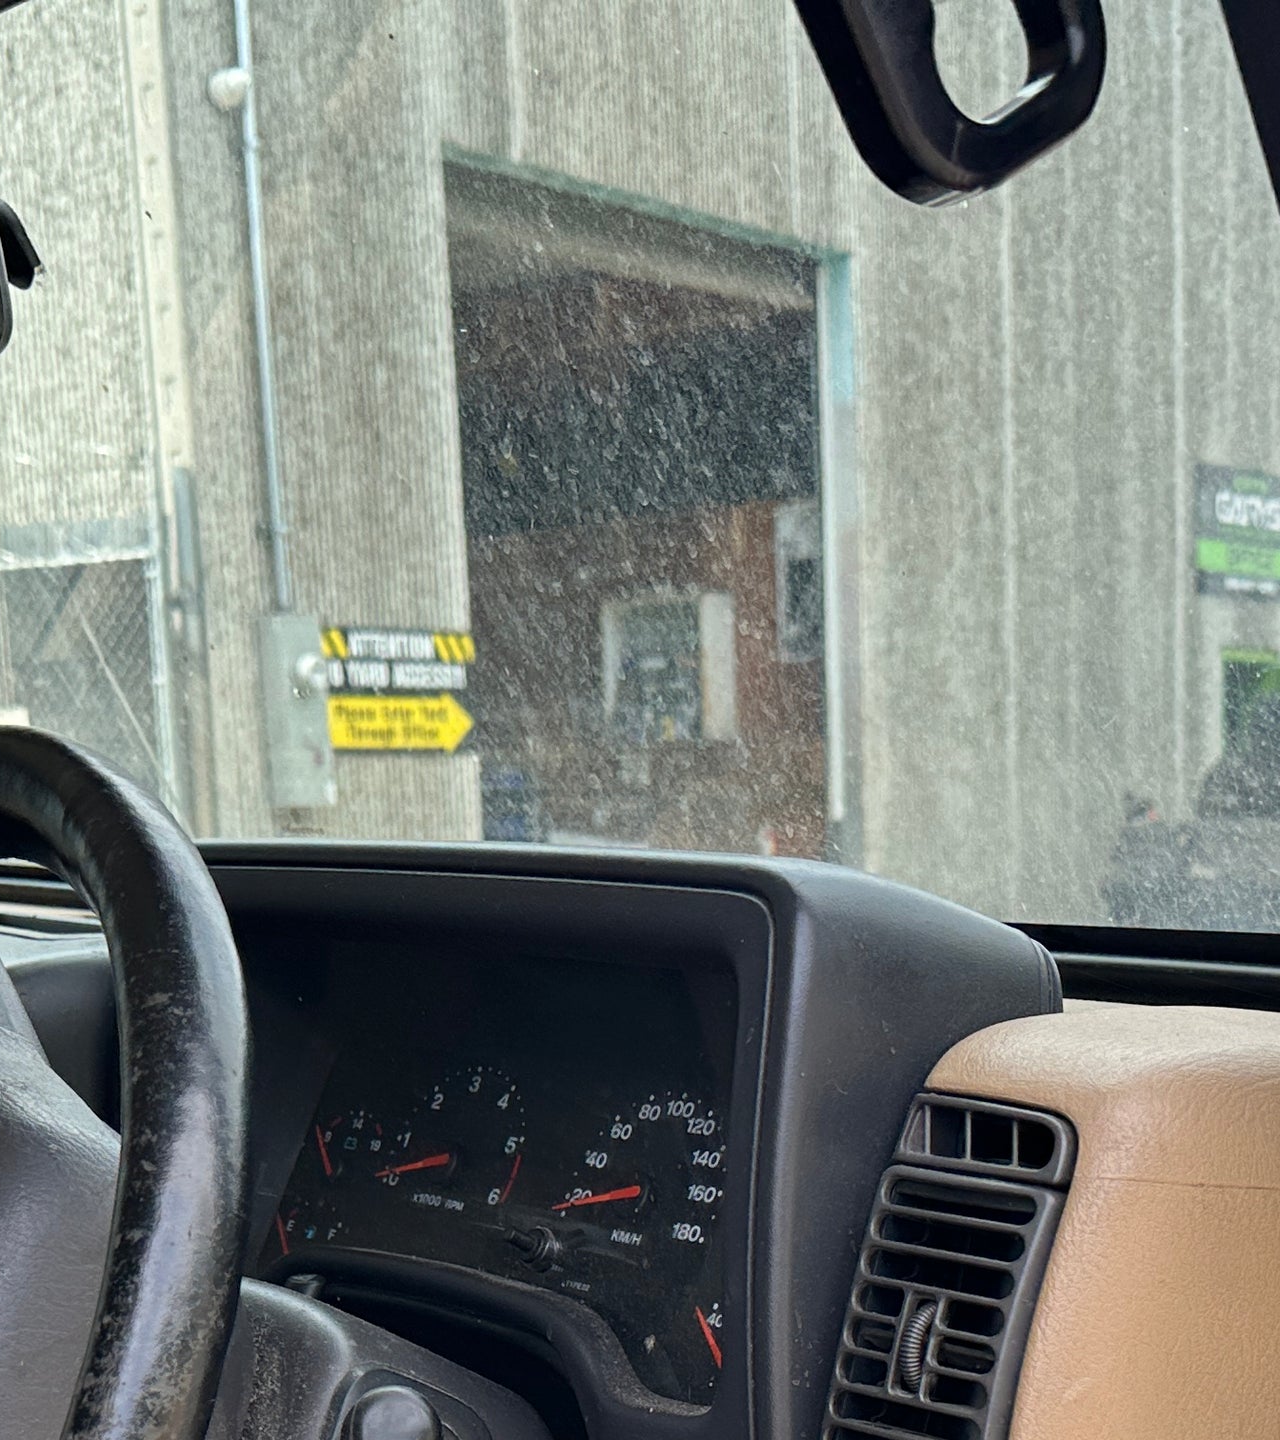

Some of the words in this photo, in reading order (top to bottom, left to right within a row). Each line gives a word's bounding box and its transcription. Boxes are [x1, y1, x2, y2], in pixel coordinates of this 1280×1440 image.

[469, 1075, 481, 1093] 3
[431, 1093, 444, 1110] 2
[497, 1093, 510, 1110] 4
[667, 1100, 695, 1118] 100
[638, 1104, 661, 1121] 80
[610, 1123, 633, 1140] 60
[687, 1117, 716, 1136] 120
[403, 1131, 412, 1149] 1
[504, 1136, 518, 1155] 5
[585, 1151, 608, 1169] 40
[692, 1150, 721, 1168] 140
[487, 1188, 501, 1206] 6
[687, 1184, 717, 1204] 160
[444, 1199, 465, 1212] RPM
[286, 1219, 296, 1232] E
[672, 1222, 701, 1243] 180
[327, 1229, 337, 1241] F
[610, 1229, 643, 1246] KM/H
